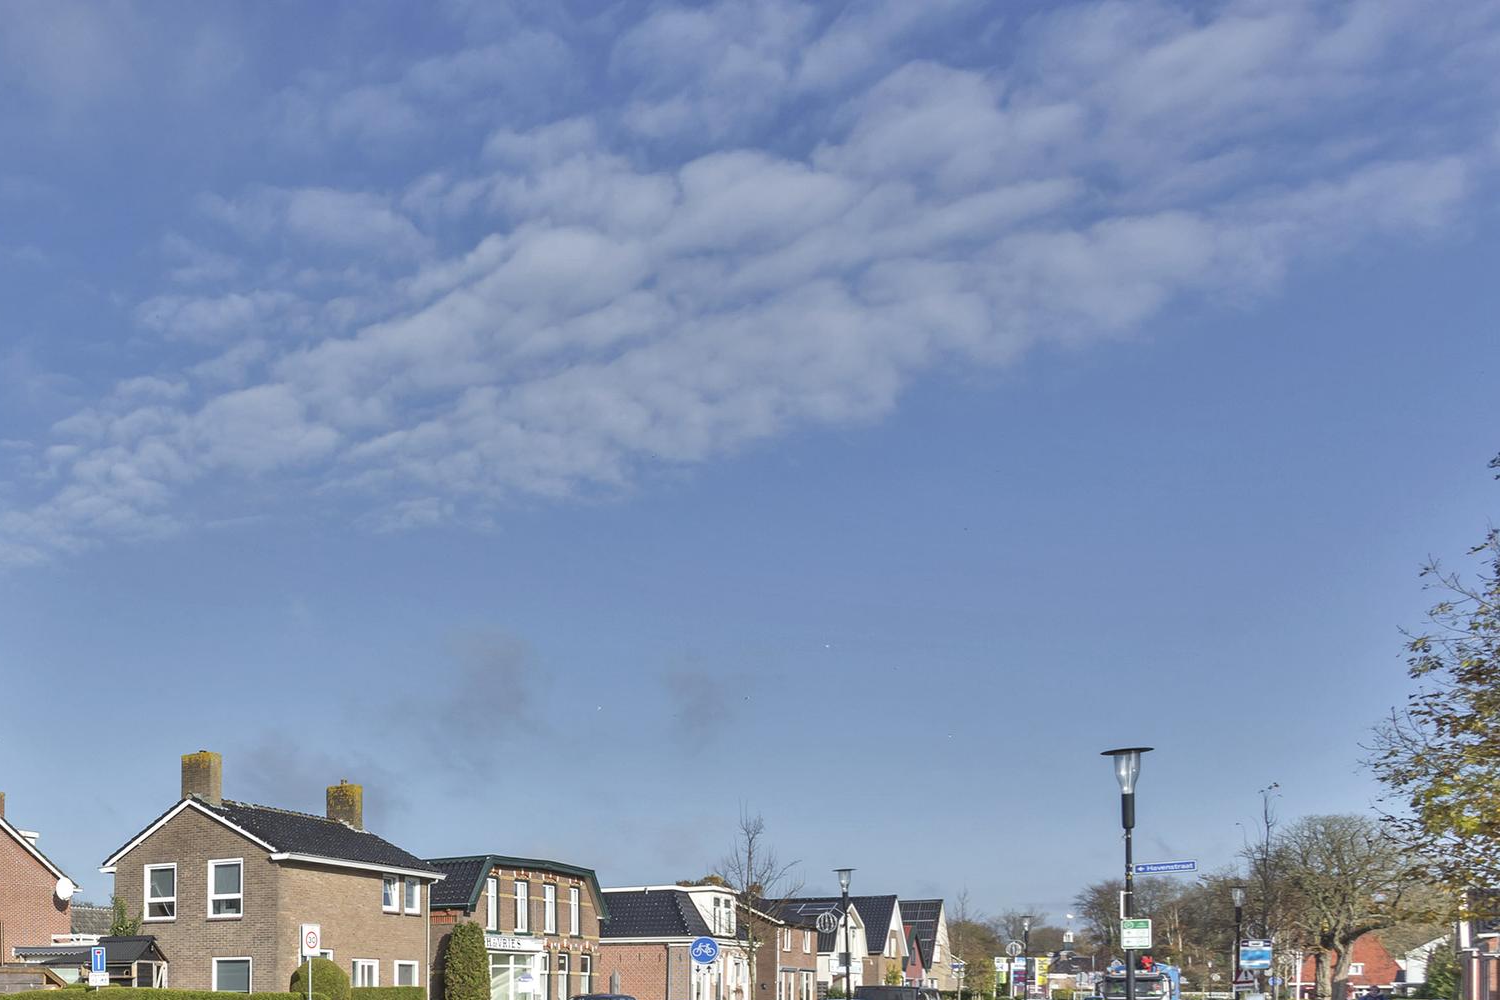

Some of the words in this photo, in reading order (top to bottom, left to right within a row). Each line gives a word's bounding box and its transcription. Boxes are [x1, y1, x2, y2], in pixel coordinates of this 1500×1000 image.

[1146, 863, 1194, 871] Havenstraat
[308, 936, 315, 944] 30
[1038, 958, 1047, 978] APK
